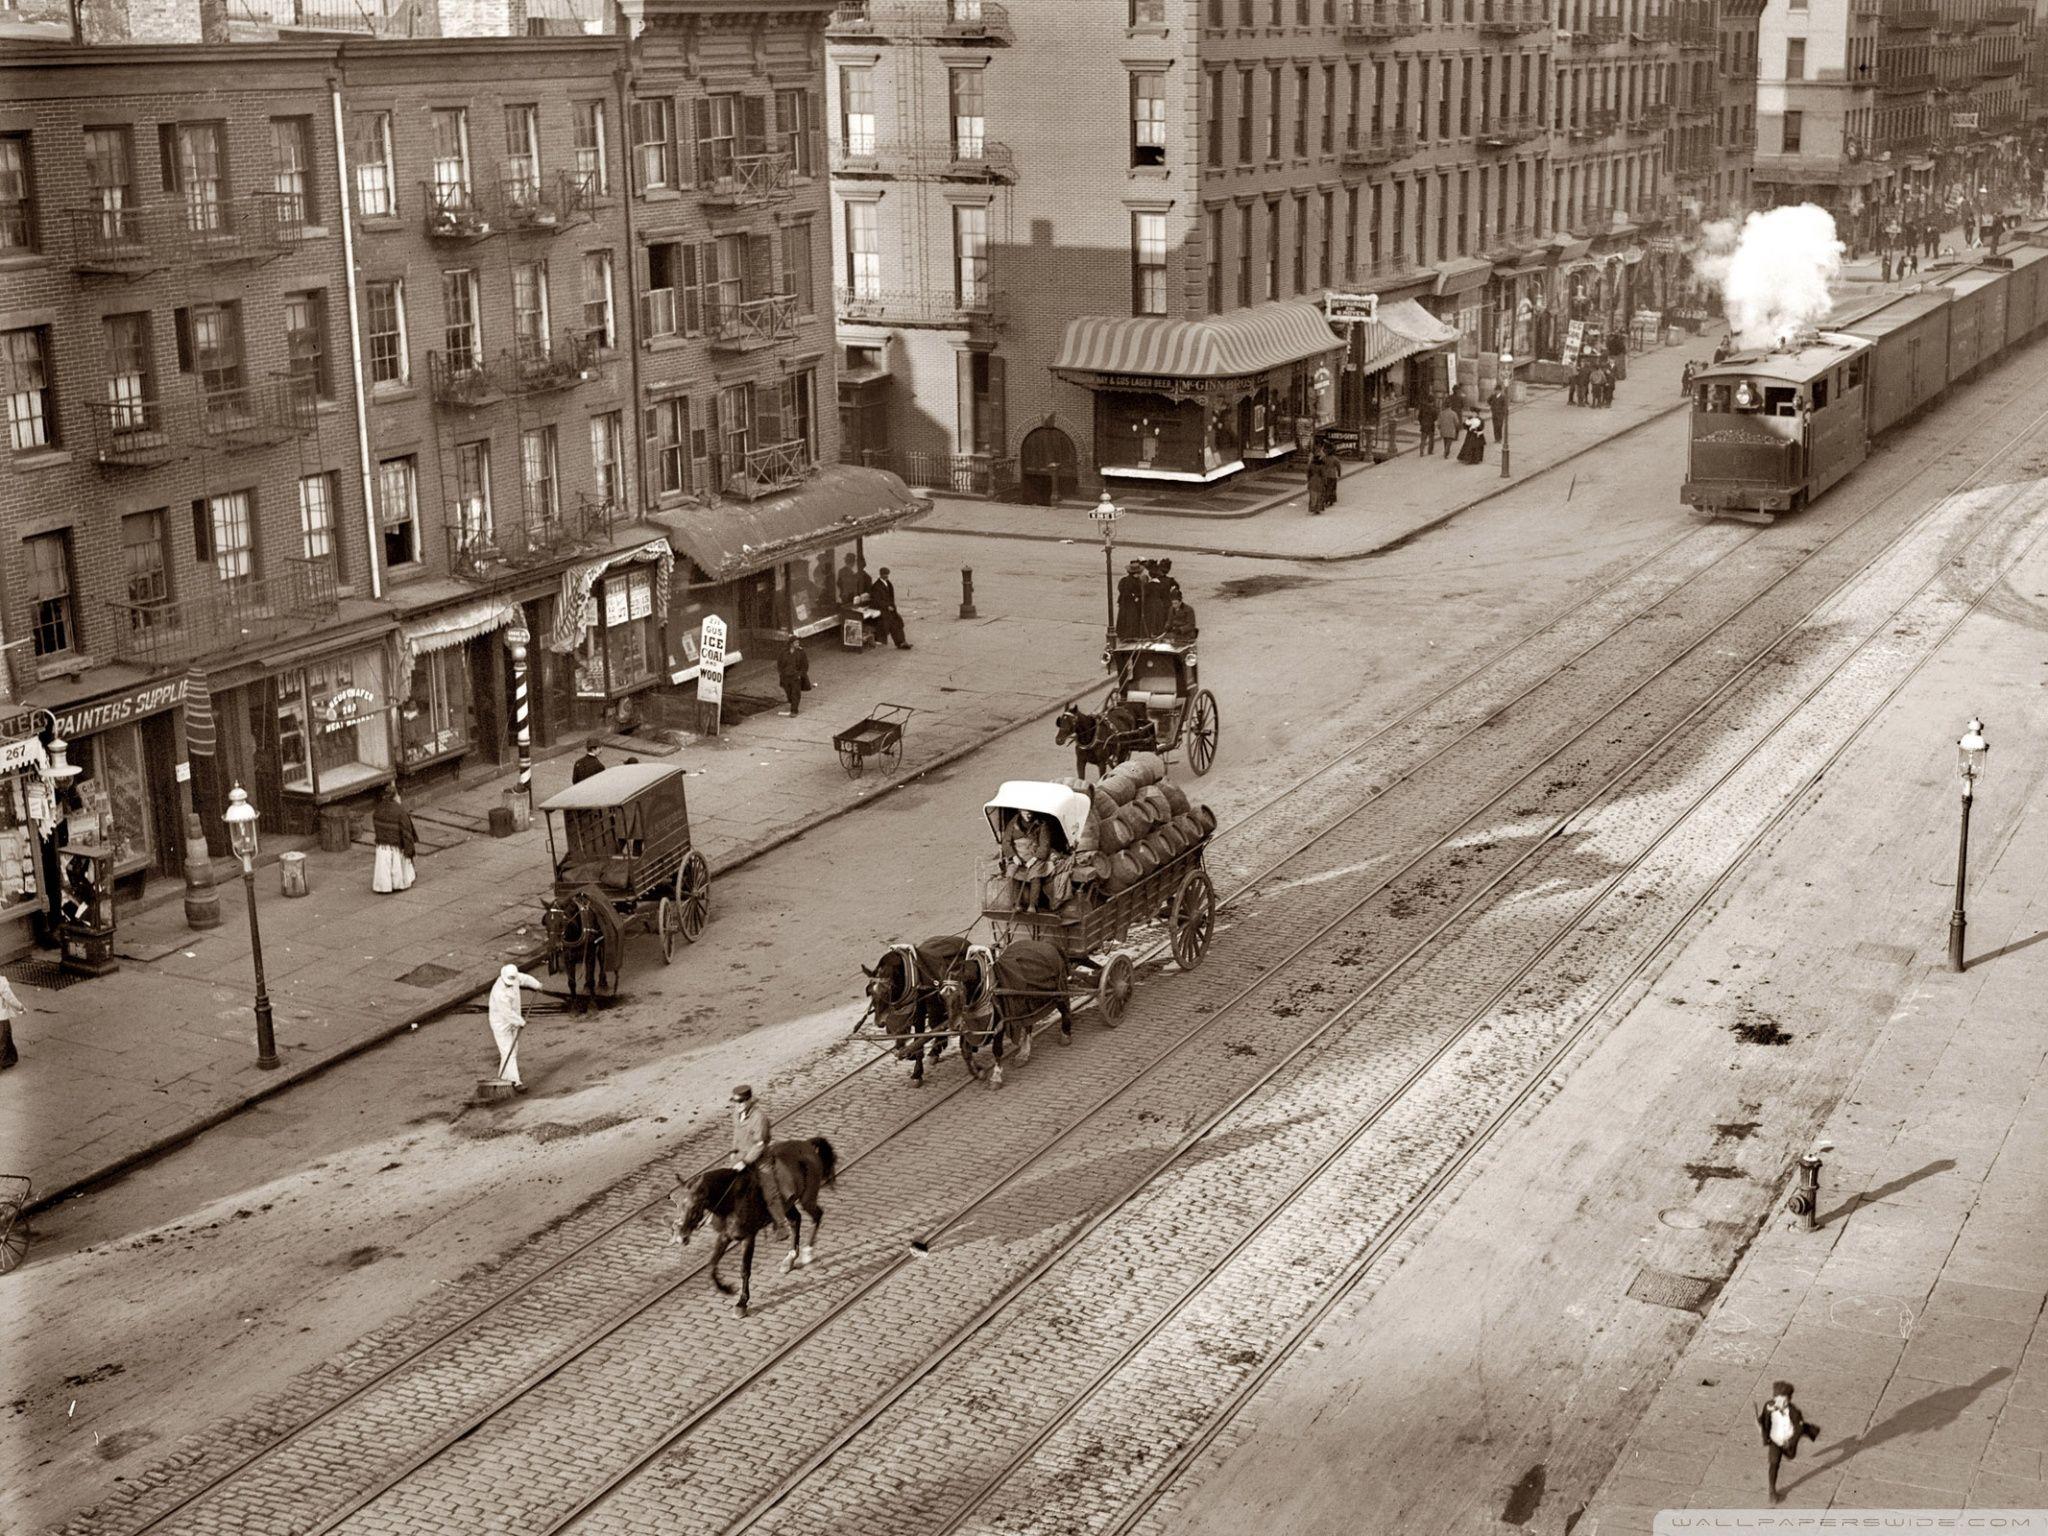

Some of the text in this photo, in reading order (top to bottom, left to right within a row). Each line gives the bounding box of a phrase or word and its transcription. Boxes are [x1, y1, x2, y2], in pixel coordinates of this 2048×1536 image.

[705, 625, 723, 637] GUS
[703, 635, 724, 650] ICE
[701, 647, 723, 663] COAL
[700, 667, 723, 683] WOOD
[55, 679, 190, 737] PAINTERS SUPPLIE
[6, 745, 26, 761] 267
[841, 740, 859, 753] ICE
